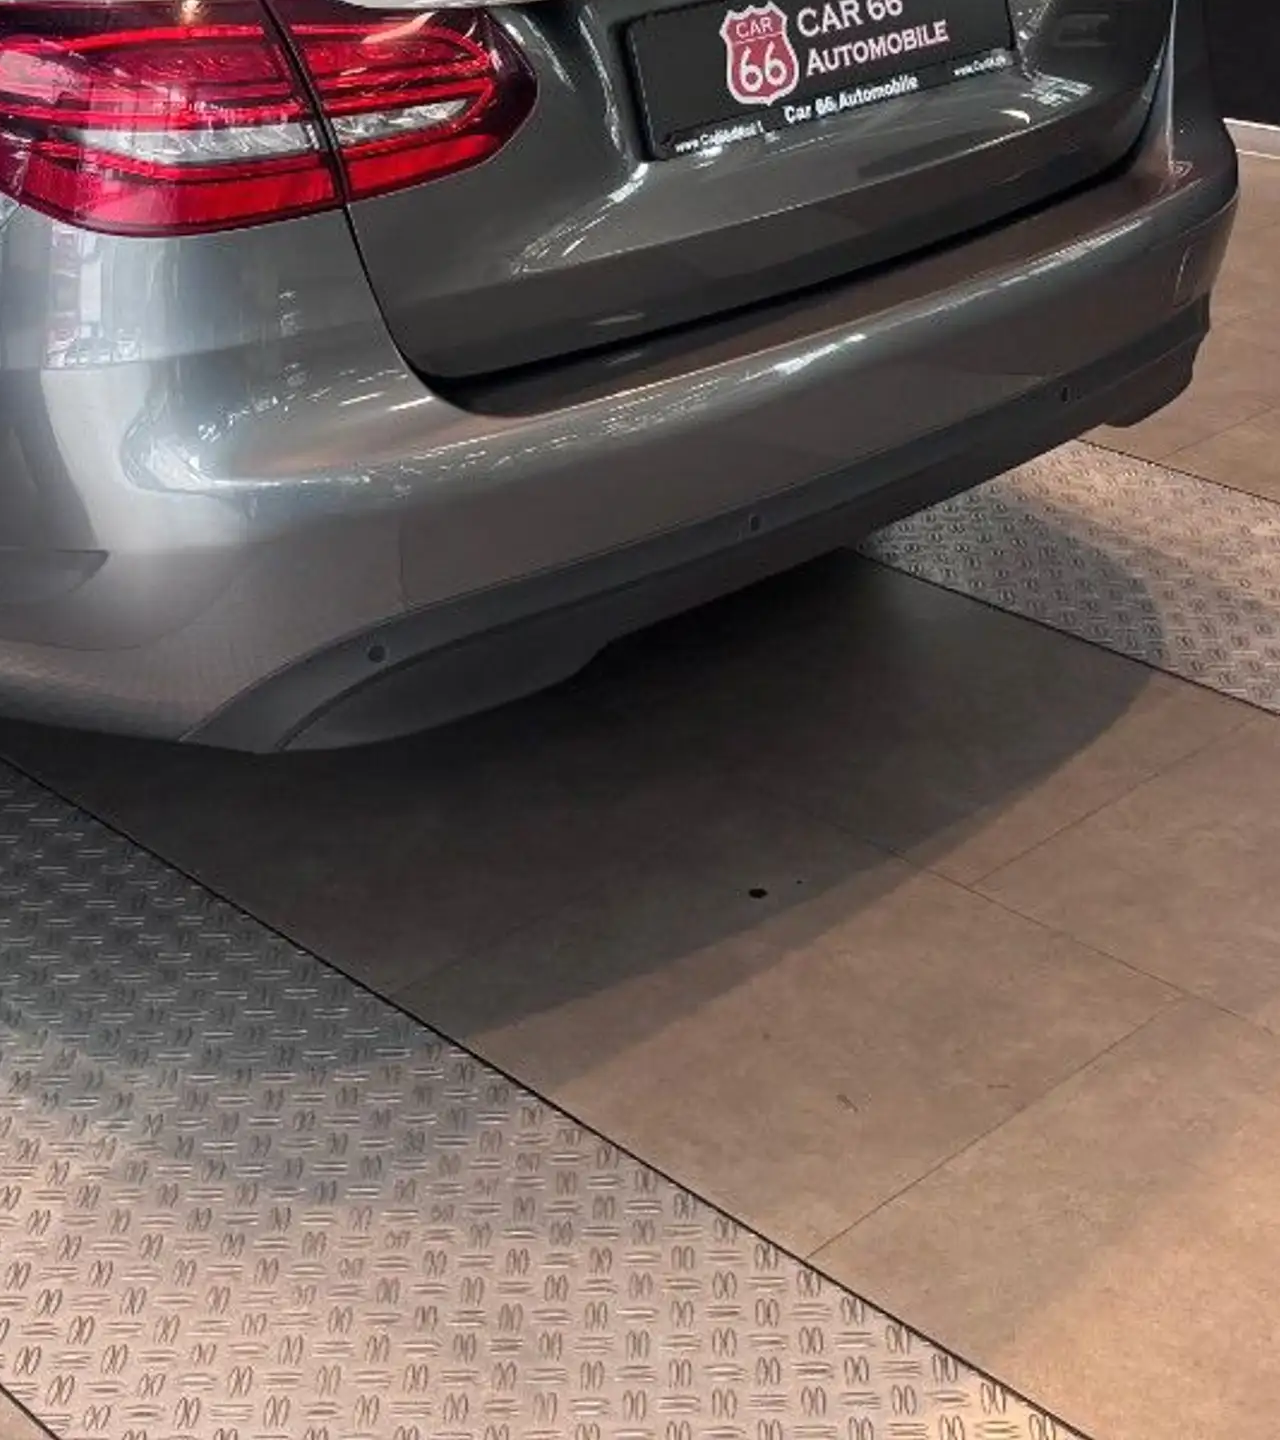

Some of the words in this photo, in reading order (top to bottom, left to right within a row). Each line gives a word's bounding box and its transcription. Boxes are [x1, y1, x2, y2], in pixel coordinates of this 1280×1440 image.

[735, 16, 774, 38] CAR
[806, 19, 950, 77] AUTOMOBILE
[740, 41, 787, 93] 66
[783, 105, 812, 124] Car
[815, 96, 838, 117] 66
[838, 74, 919, 110] Automobile
